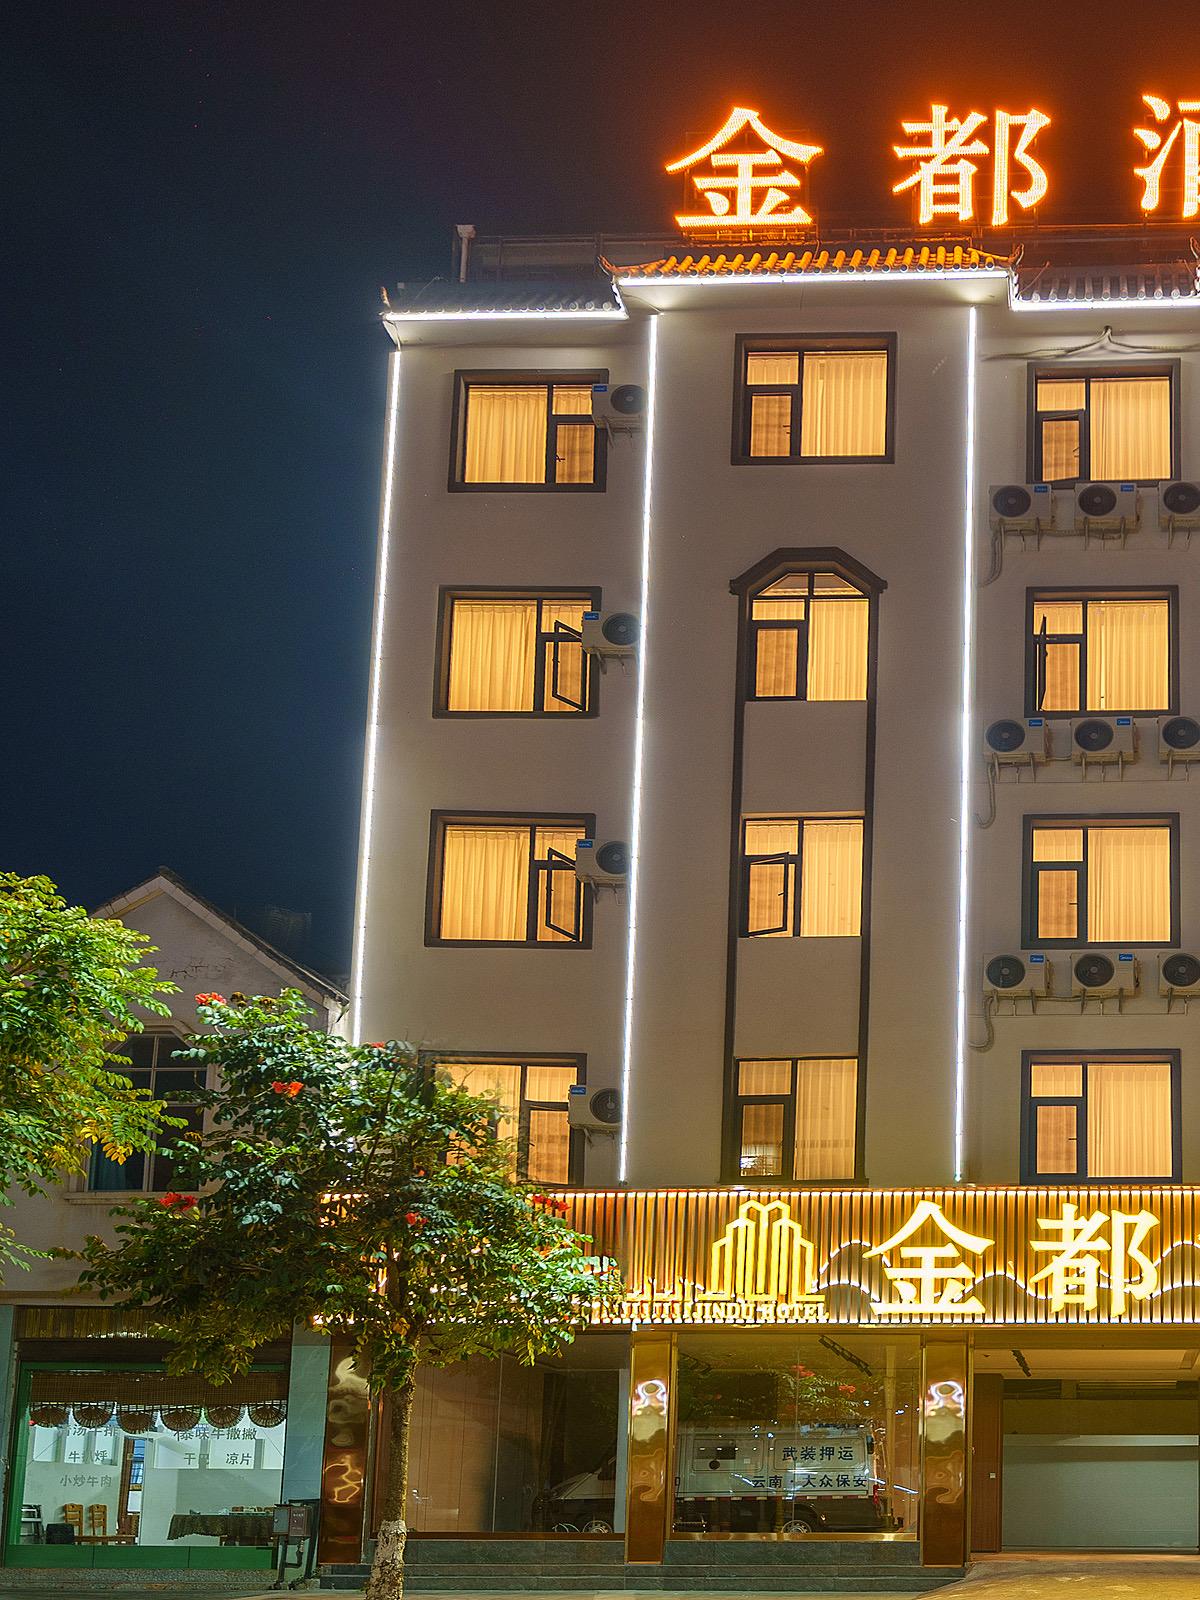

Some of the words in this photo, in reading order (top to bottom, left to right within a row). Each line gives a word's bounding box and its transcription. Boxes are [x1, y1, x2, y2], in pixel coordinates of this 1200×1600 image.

[693, 1302, 755, 1319] JINDU
[760, 1302, 829, 1319] HOTEL
[225, 1452, 252, 1466] 凉片
[782, 1445, 854, 1461] 武装押运
[60, 1474, 112, 1488] 小炒牛肉
